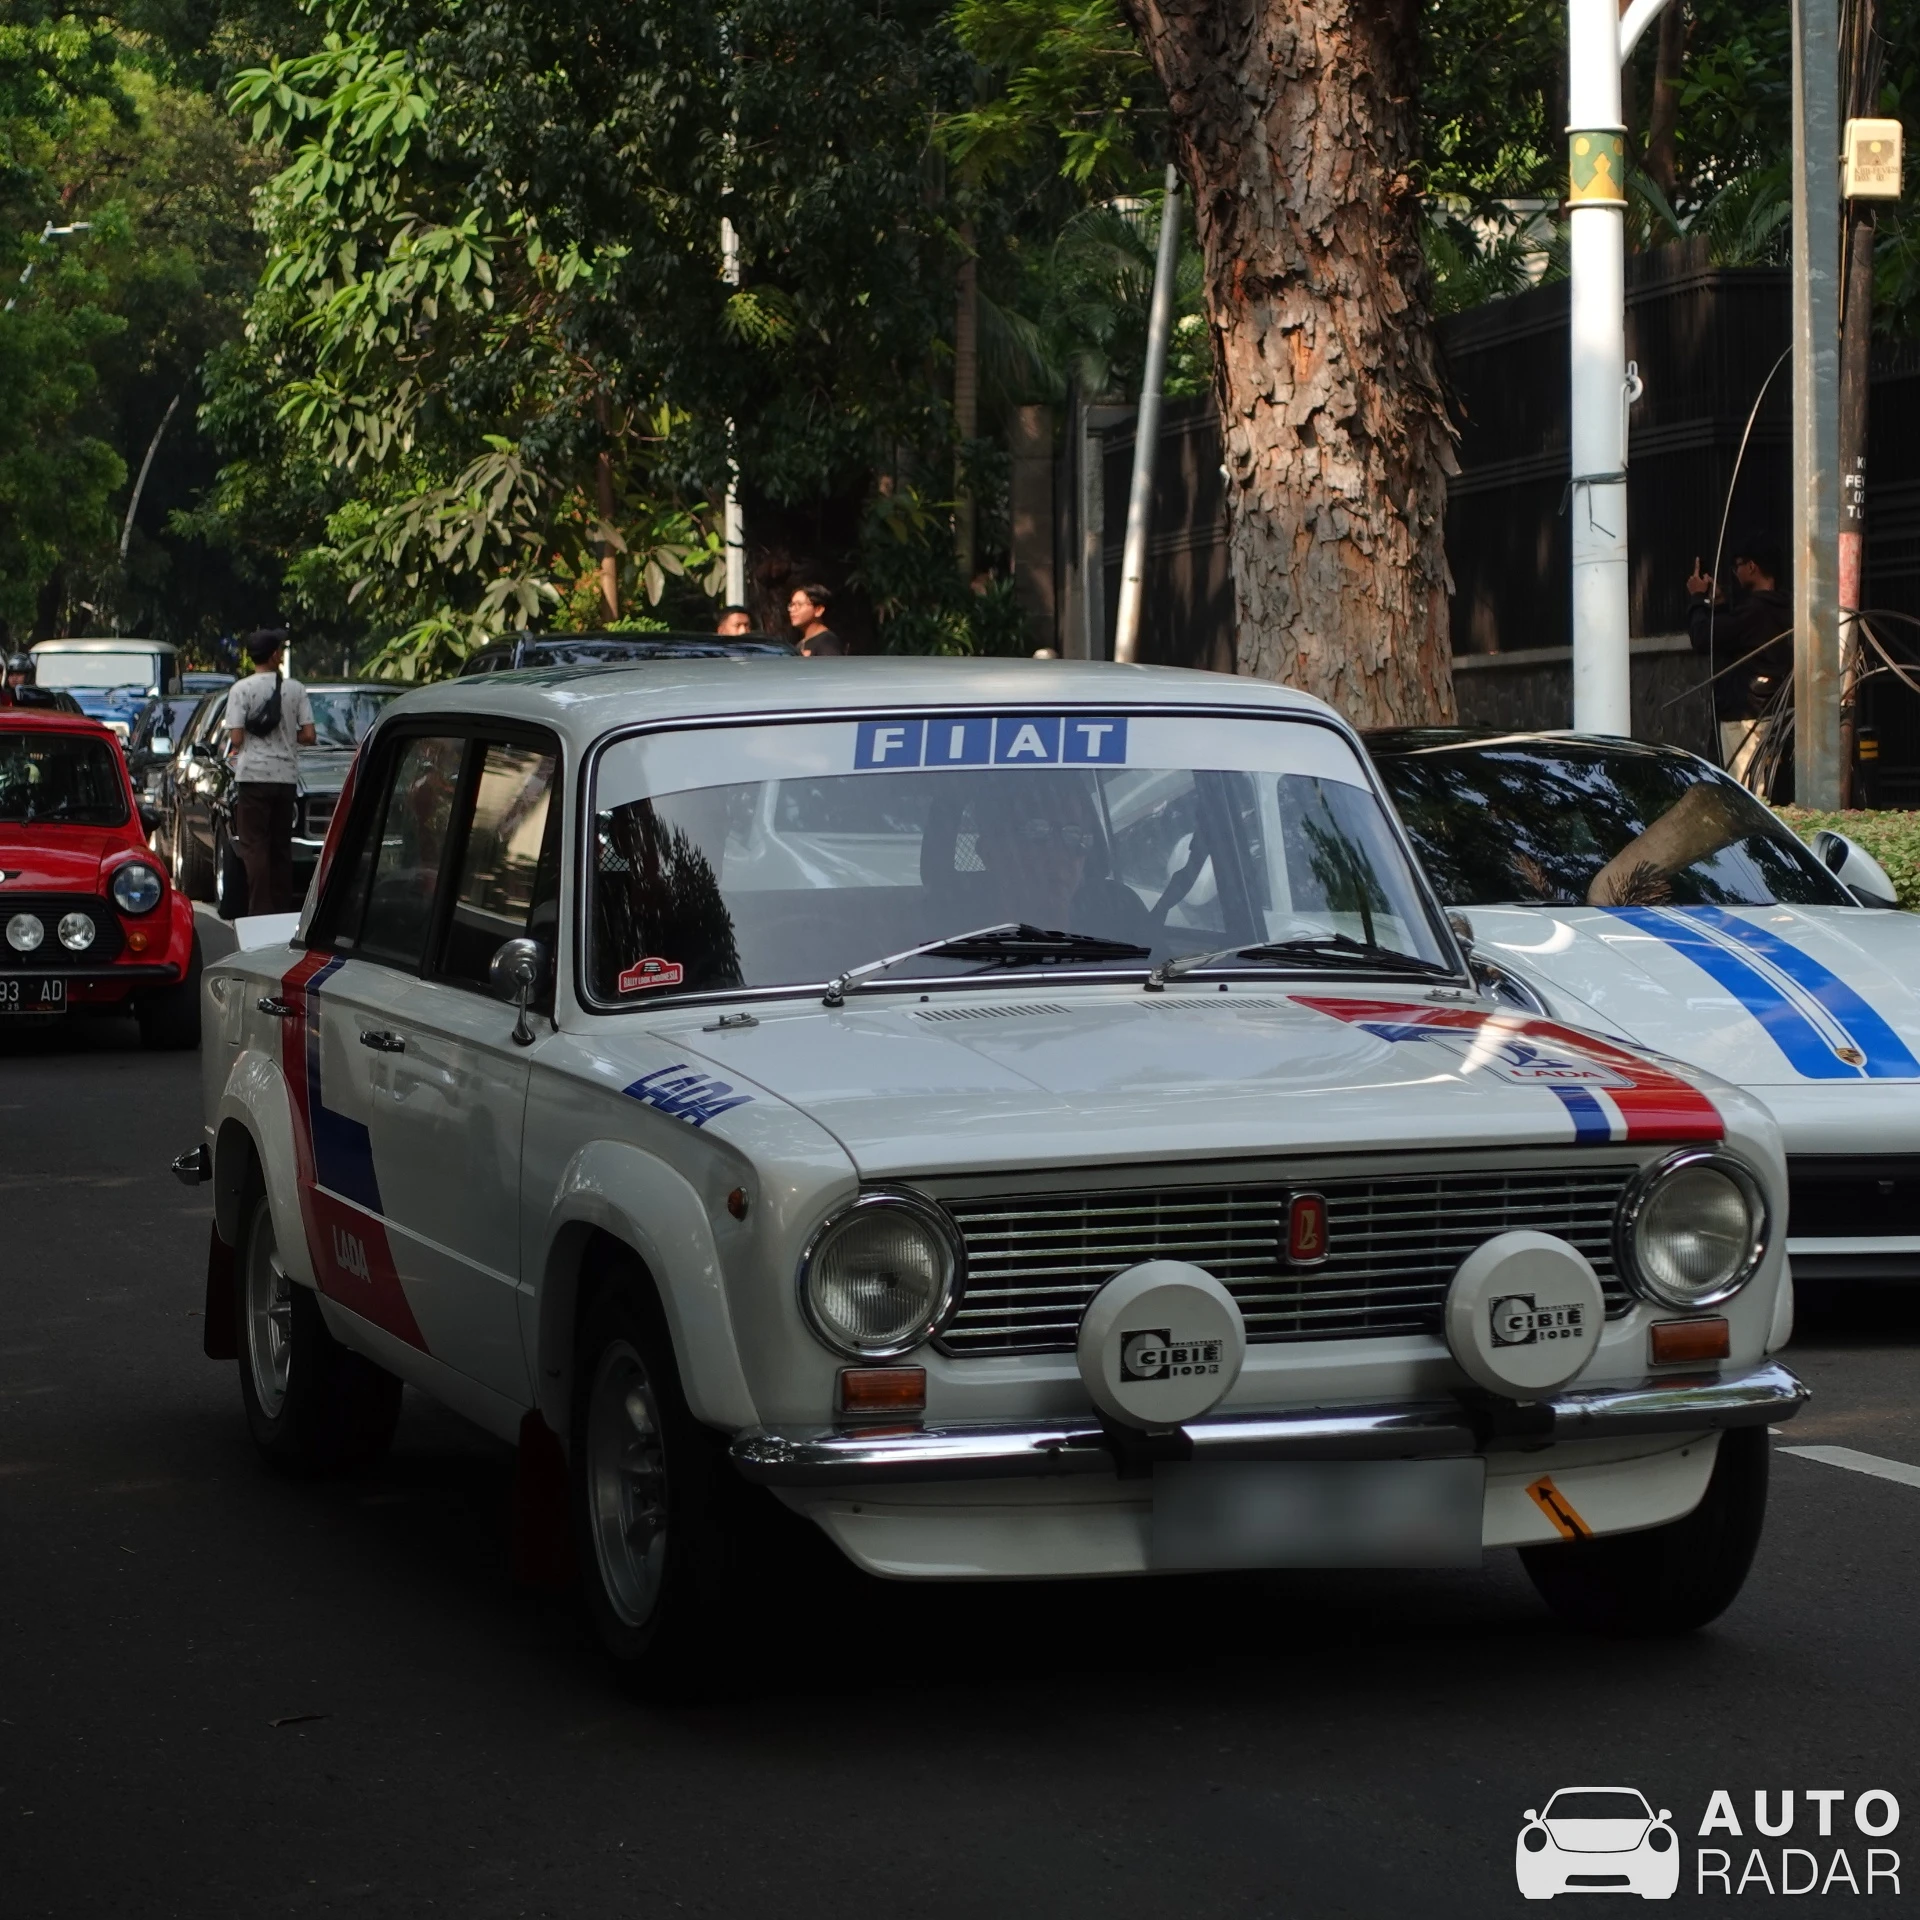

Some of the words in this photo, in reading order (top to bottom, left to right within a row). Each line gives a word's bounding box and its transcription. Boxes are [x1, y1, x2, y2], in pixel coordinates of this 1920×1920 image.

[871, 723, 1114, 763] FIAT
[40, 979, 62, 1001] AD
[1509, 1069, 1605, 1079] LADA
[621, 1063, 757, 1128] LADA
[332, 1224, 372, 1284] LADA
[1539, 1328, 1583, 1341] IODE
[1172, 1364, 1219, 1377] IODE
